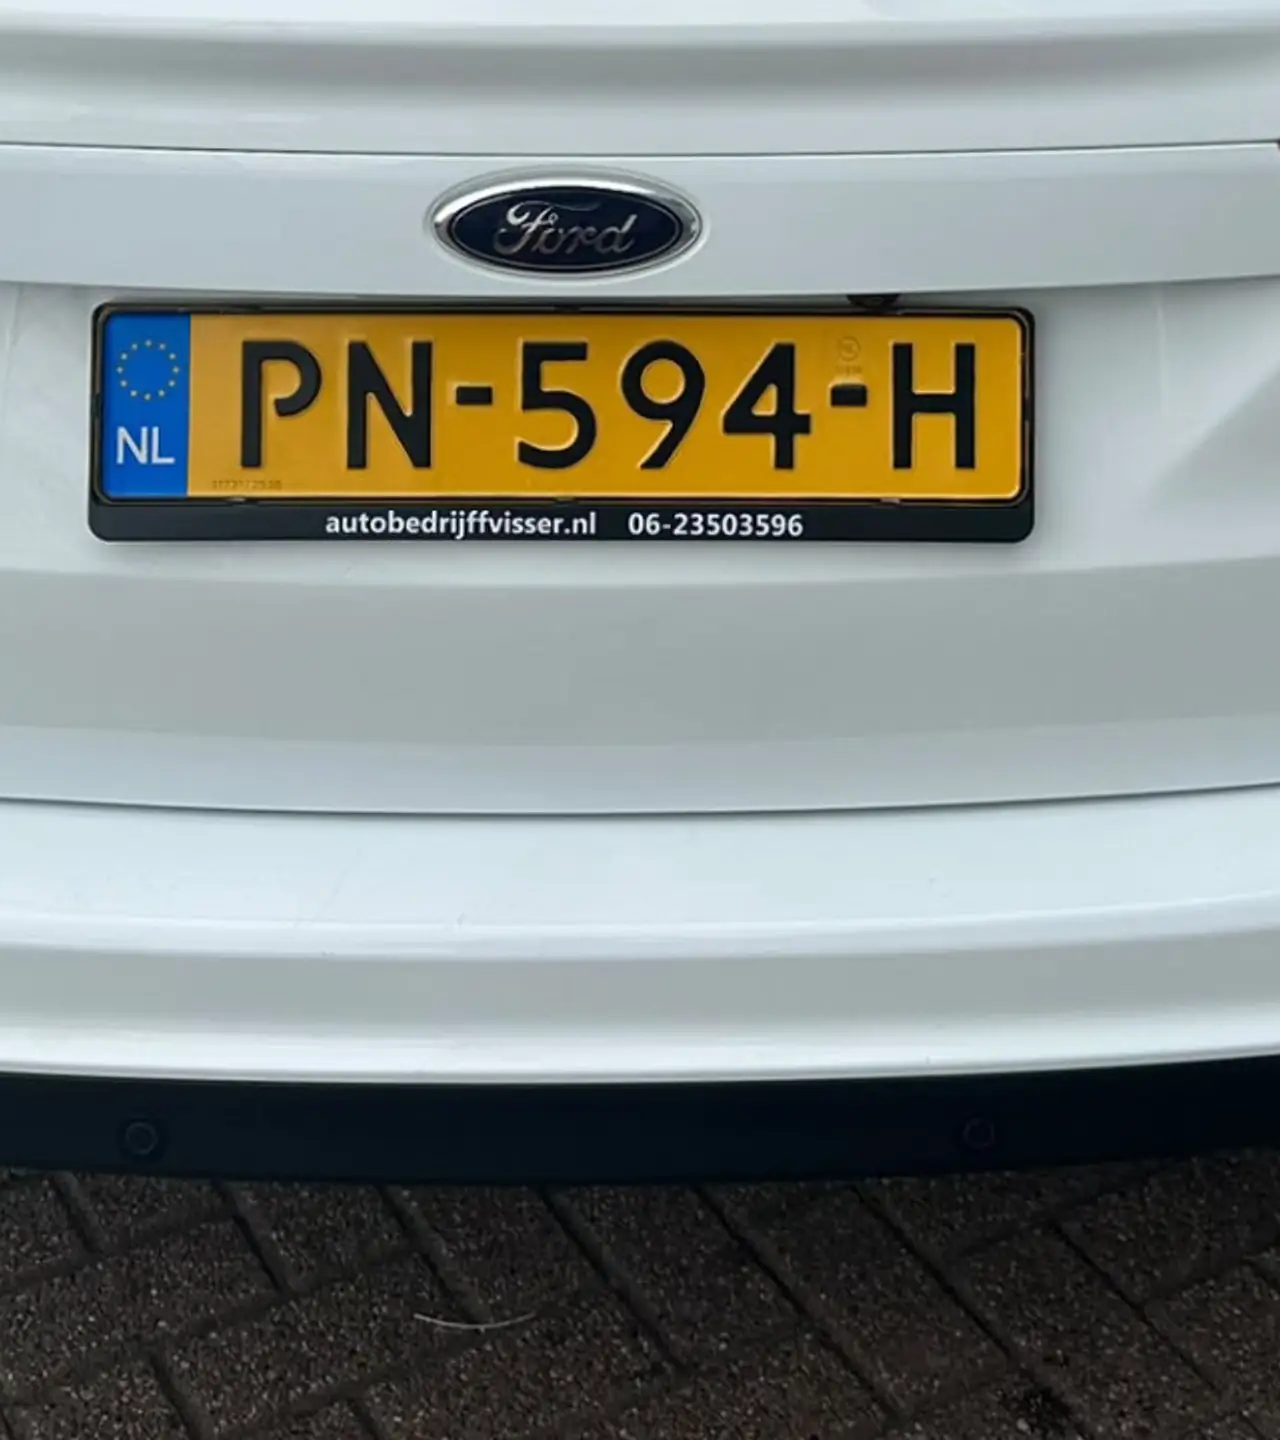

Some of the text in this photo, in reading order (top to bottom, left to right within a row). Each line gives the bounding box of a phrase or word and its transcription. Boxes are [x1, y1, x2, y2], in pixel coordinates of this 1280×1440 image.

[492, 199, 638, 256] Ford
[240, 340, 977, 471] PN-594-H
[116, 425, 176, 465] NL
[324, 508, 805, 540] autobedrijffvisser.nl 06-23503596
